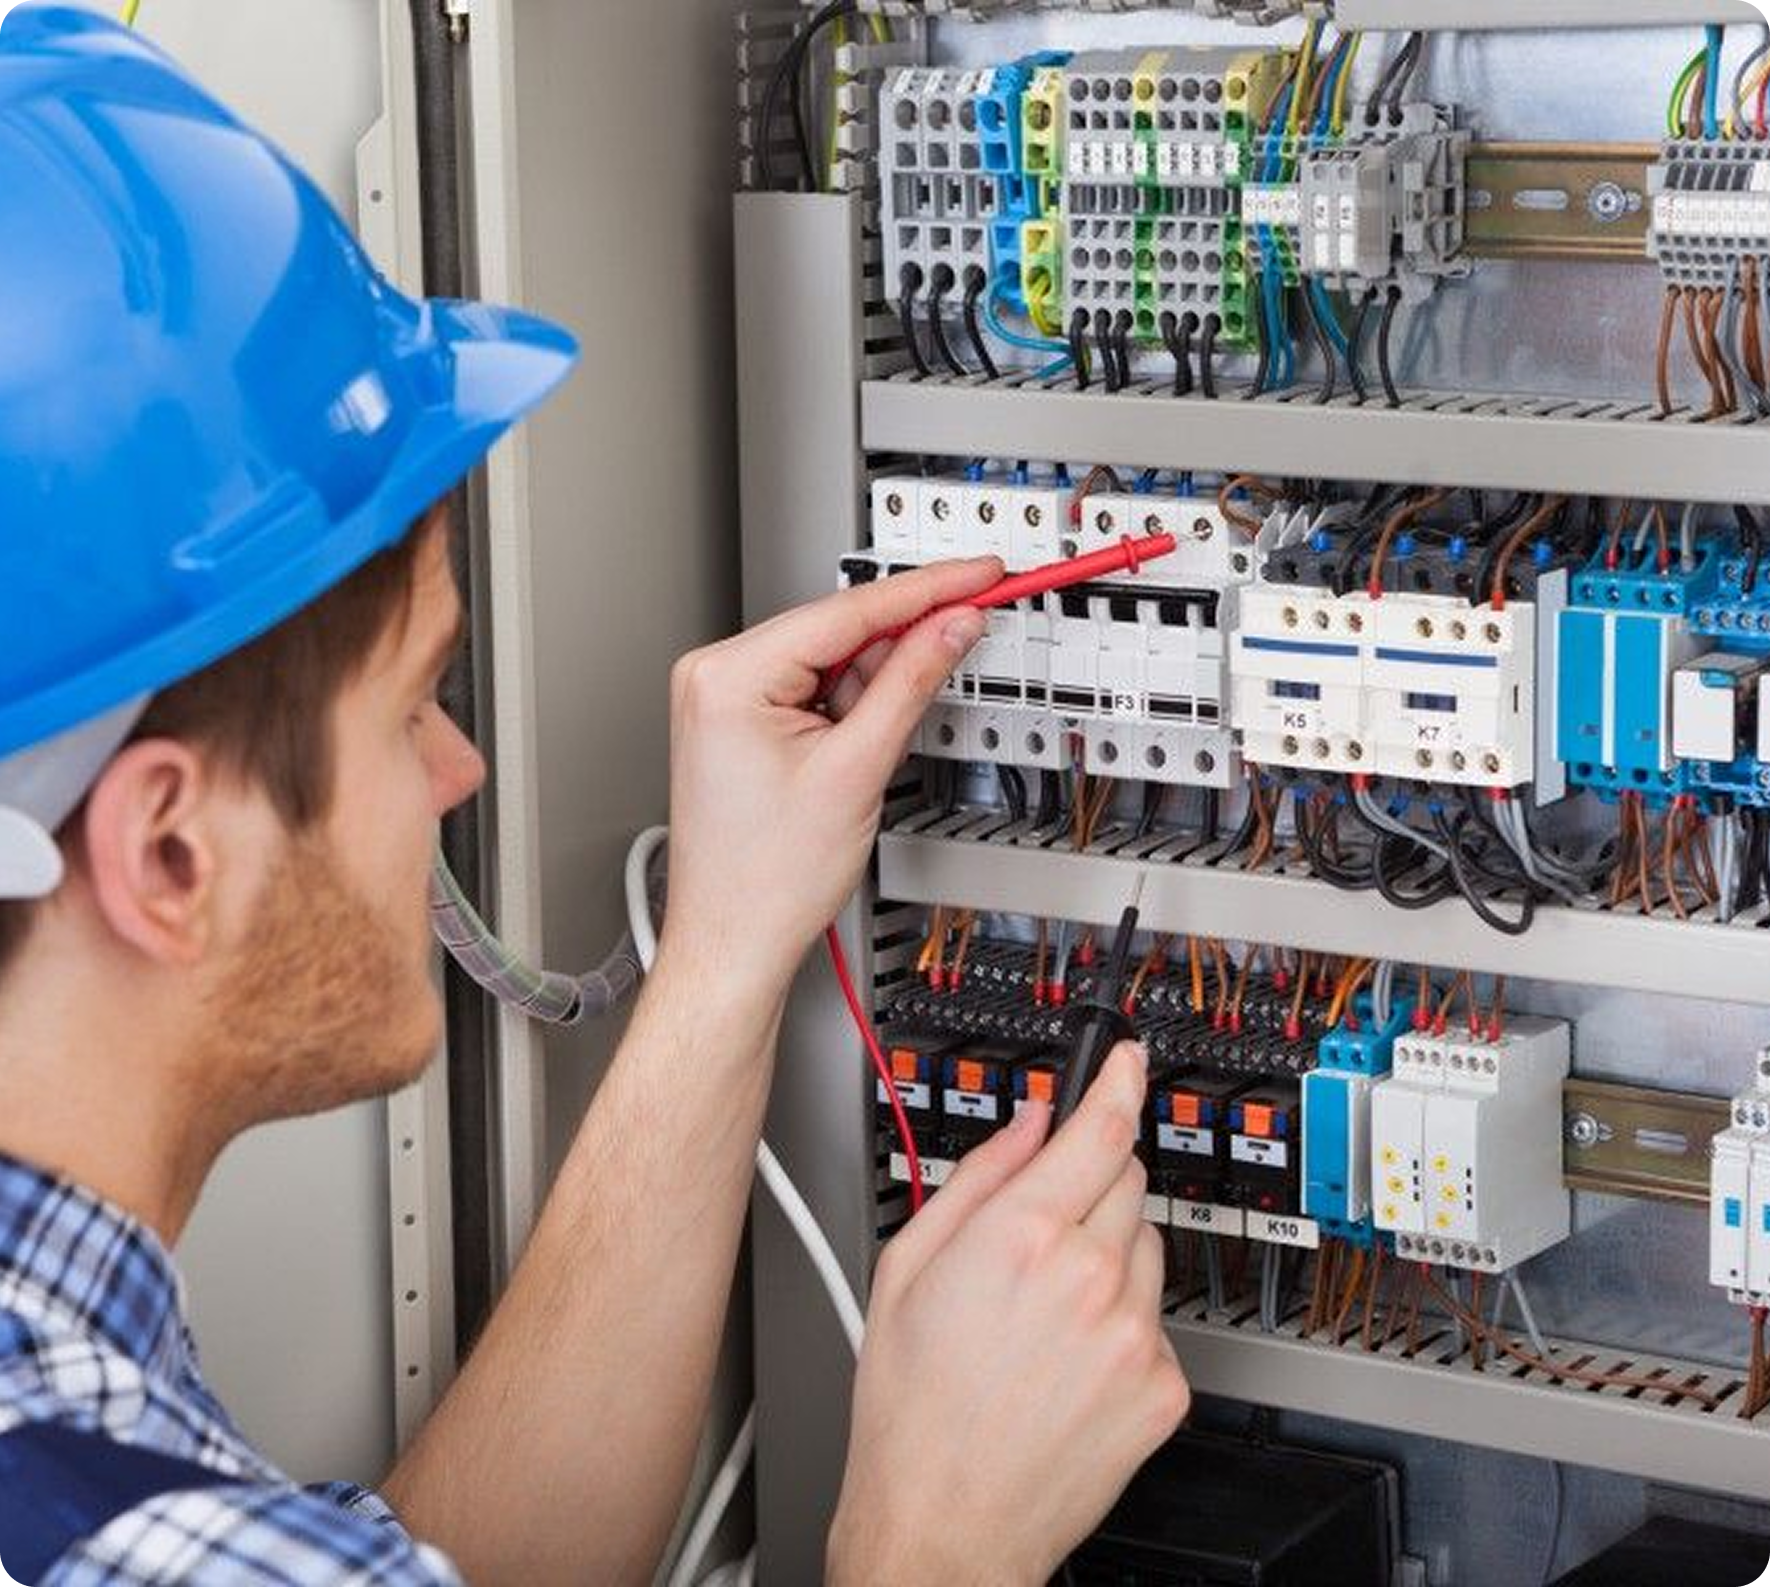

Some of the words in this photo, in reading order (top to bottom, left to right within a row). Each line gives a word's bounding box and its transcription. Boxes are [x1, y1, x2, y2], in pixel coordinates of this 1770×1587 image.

[1115, 694, 1134, 710] F3
[1283, 713, 1307, 728] K5
[1417, 725, 1440, 741] K7
[1267, 1219, 1299, 1238] K10
